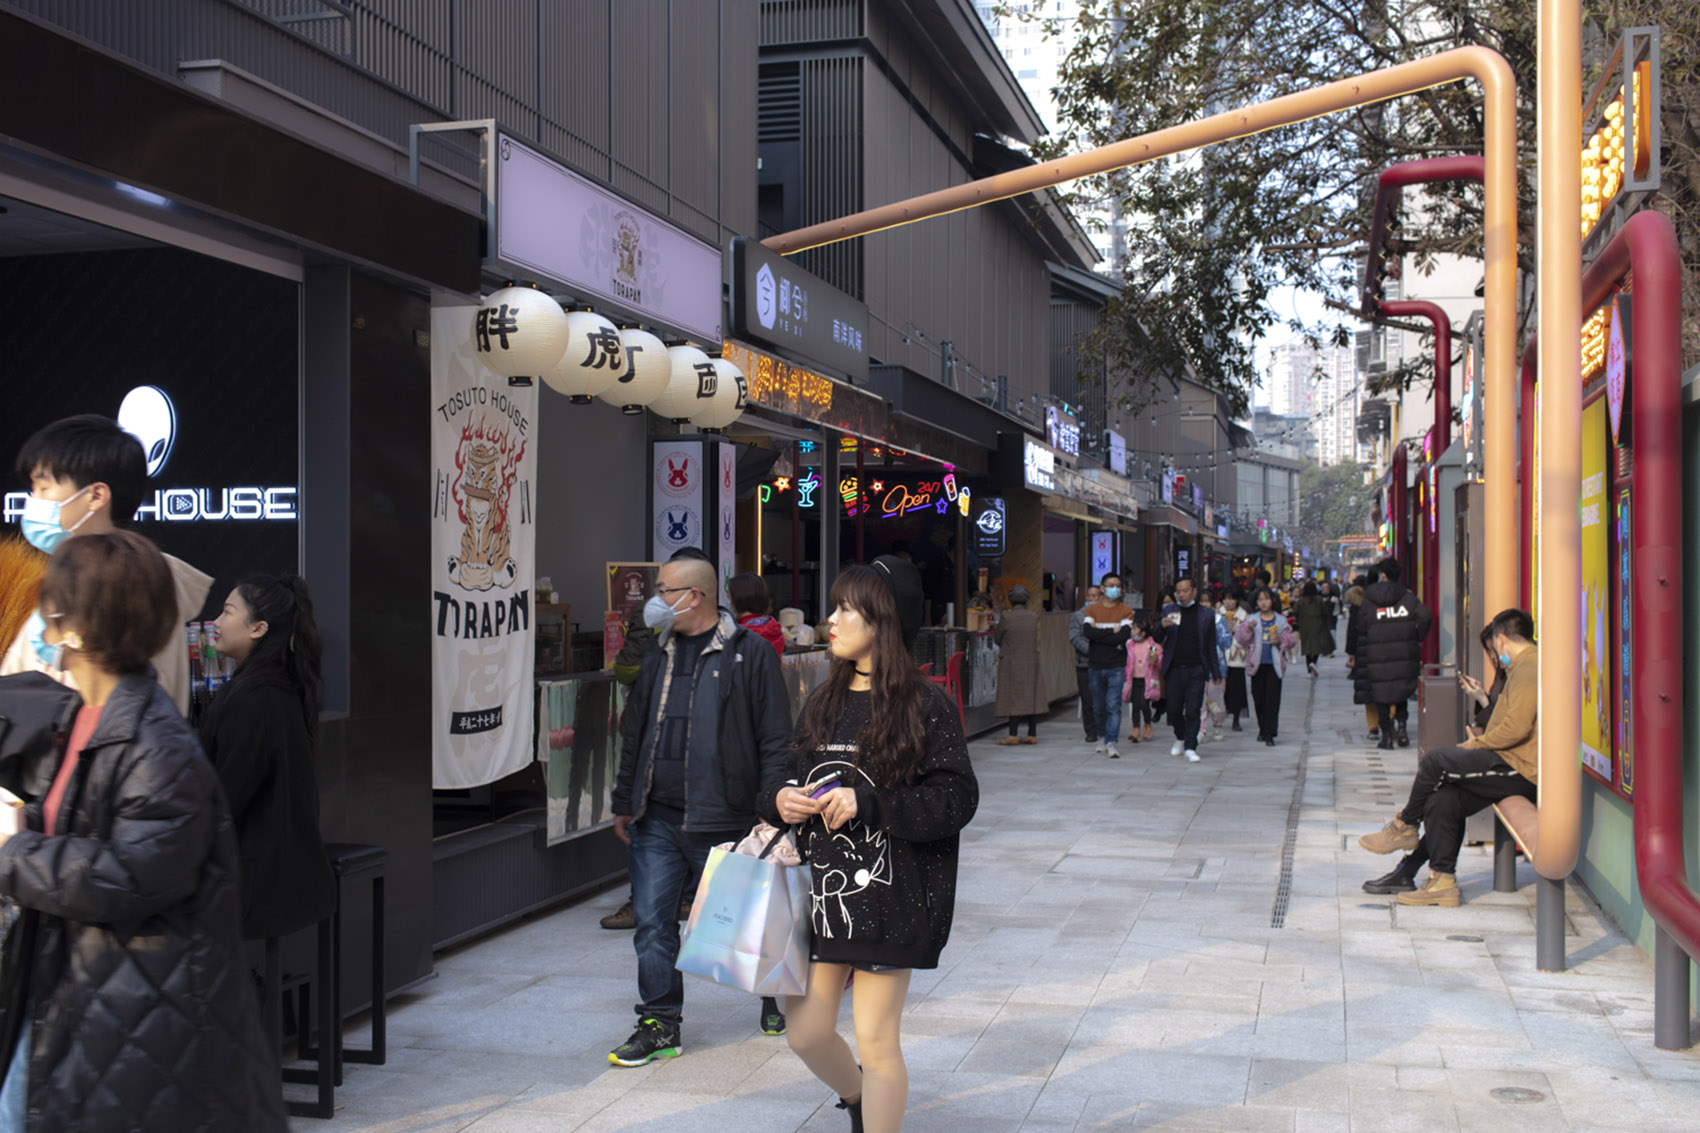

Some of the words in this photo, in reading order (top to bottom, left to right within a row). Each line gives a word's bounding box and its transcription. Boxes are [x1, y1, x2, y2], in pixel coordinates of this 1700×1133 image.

[476, 303, 519, 352] 胖
[832, 318, 862, 352] 南洋风味
[580, 326, 621, 371] 虎
[437, 386, 487, 422] TOSUTO
[491, 389, 529, 436] HOUSE
[134, 487, 297, 521] HOUSE
[882, 484, 930, 517] Open
[917, 481, 941, 494] 24/7
[433, 589, 529, 639] TORAPAN
[1375, 605, 1409, 620] FILA
